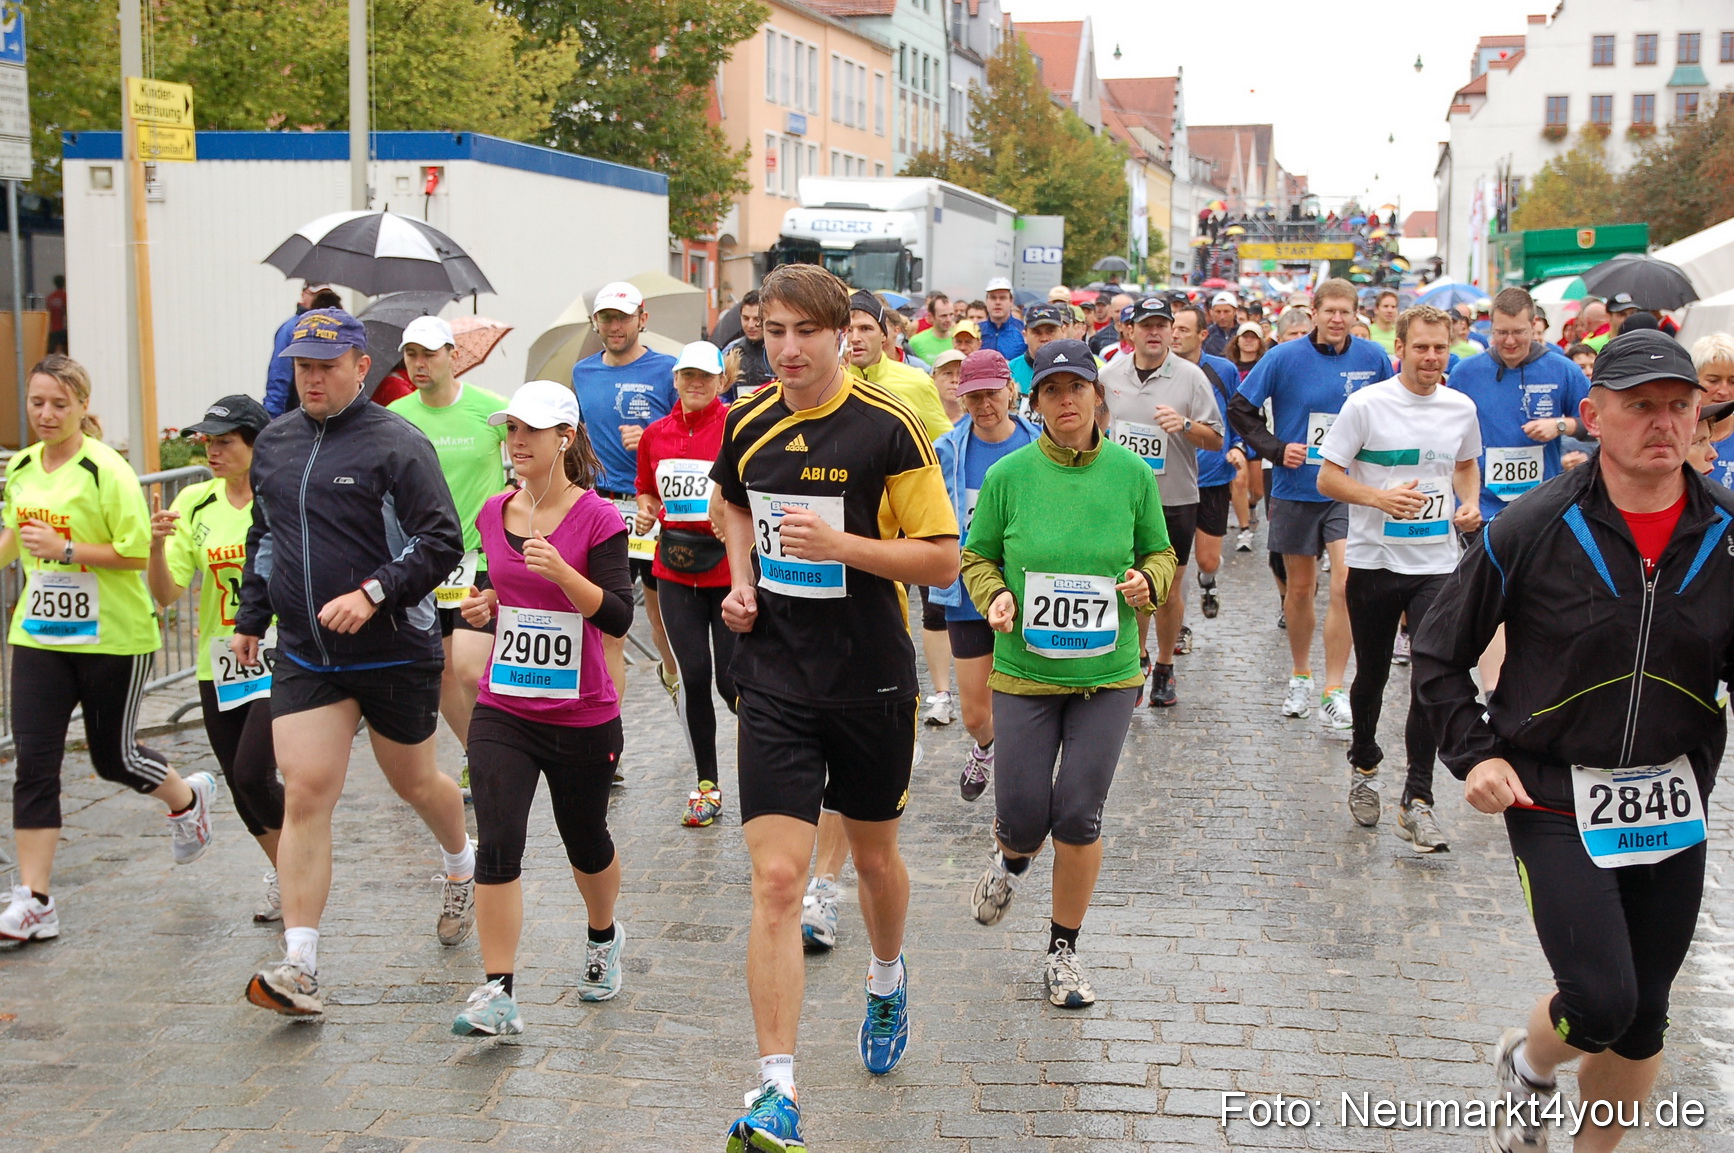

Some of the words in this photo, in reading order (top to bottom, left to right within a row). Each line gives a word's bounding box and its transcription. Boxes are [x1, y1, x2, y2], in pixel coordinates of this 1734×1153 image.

[140, 84, 174, 100] Kinder-
[133, 101, 182, 123] betreuung
[811, 219, 872, 233] BOCK
[1023, 245, 1062, 264] BO
[1275, 246, 1314, 256] START
[1119, 434, 1162, 457] 2539
[800, 467, 825, 480] ABI
[829, 468, 848, 482] 09
[1493, 460, 1538, 481] 2868
[662, 475, 708, 498] 2583
[17, 507, 70, 525] Müller
[673, 503, 692, 514] Margit
[1408, 526, 1430, 535] Sven
[668, 545, 694, 557] CAMEL
[768, 563, 822, 583] Johannes
[1054, 579, 1091, 589] BOCK
[32, 590, 90, 619] 2598
[1033, 596, 1109, 628] 2057
[500, 630, 572, 667] 2909
[1051, 634, 1088, 649] Conny
[509, 670, 552, 686] Nadine
[1589, 776, 1691, 825] 2846
[1617, 830, 1669, 849] Albert
